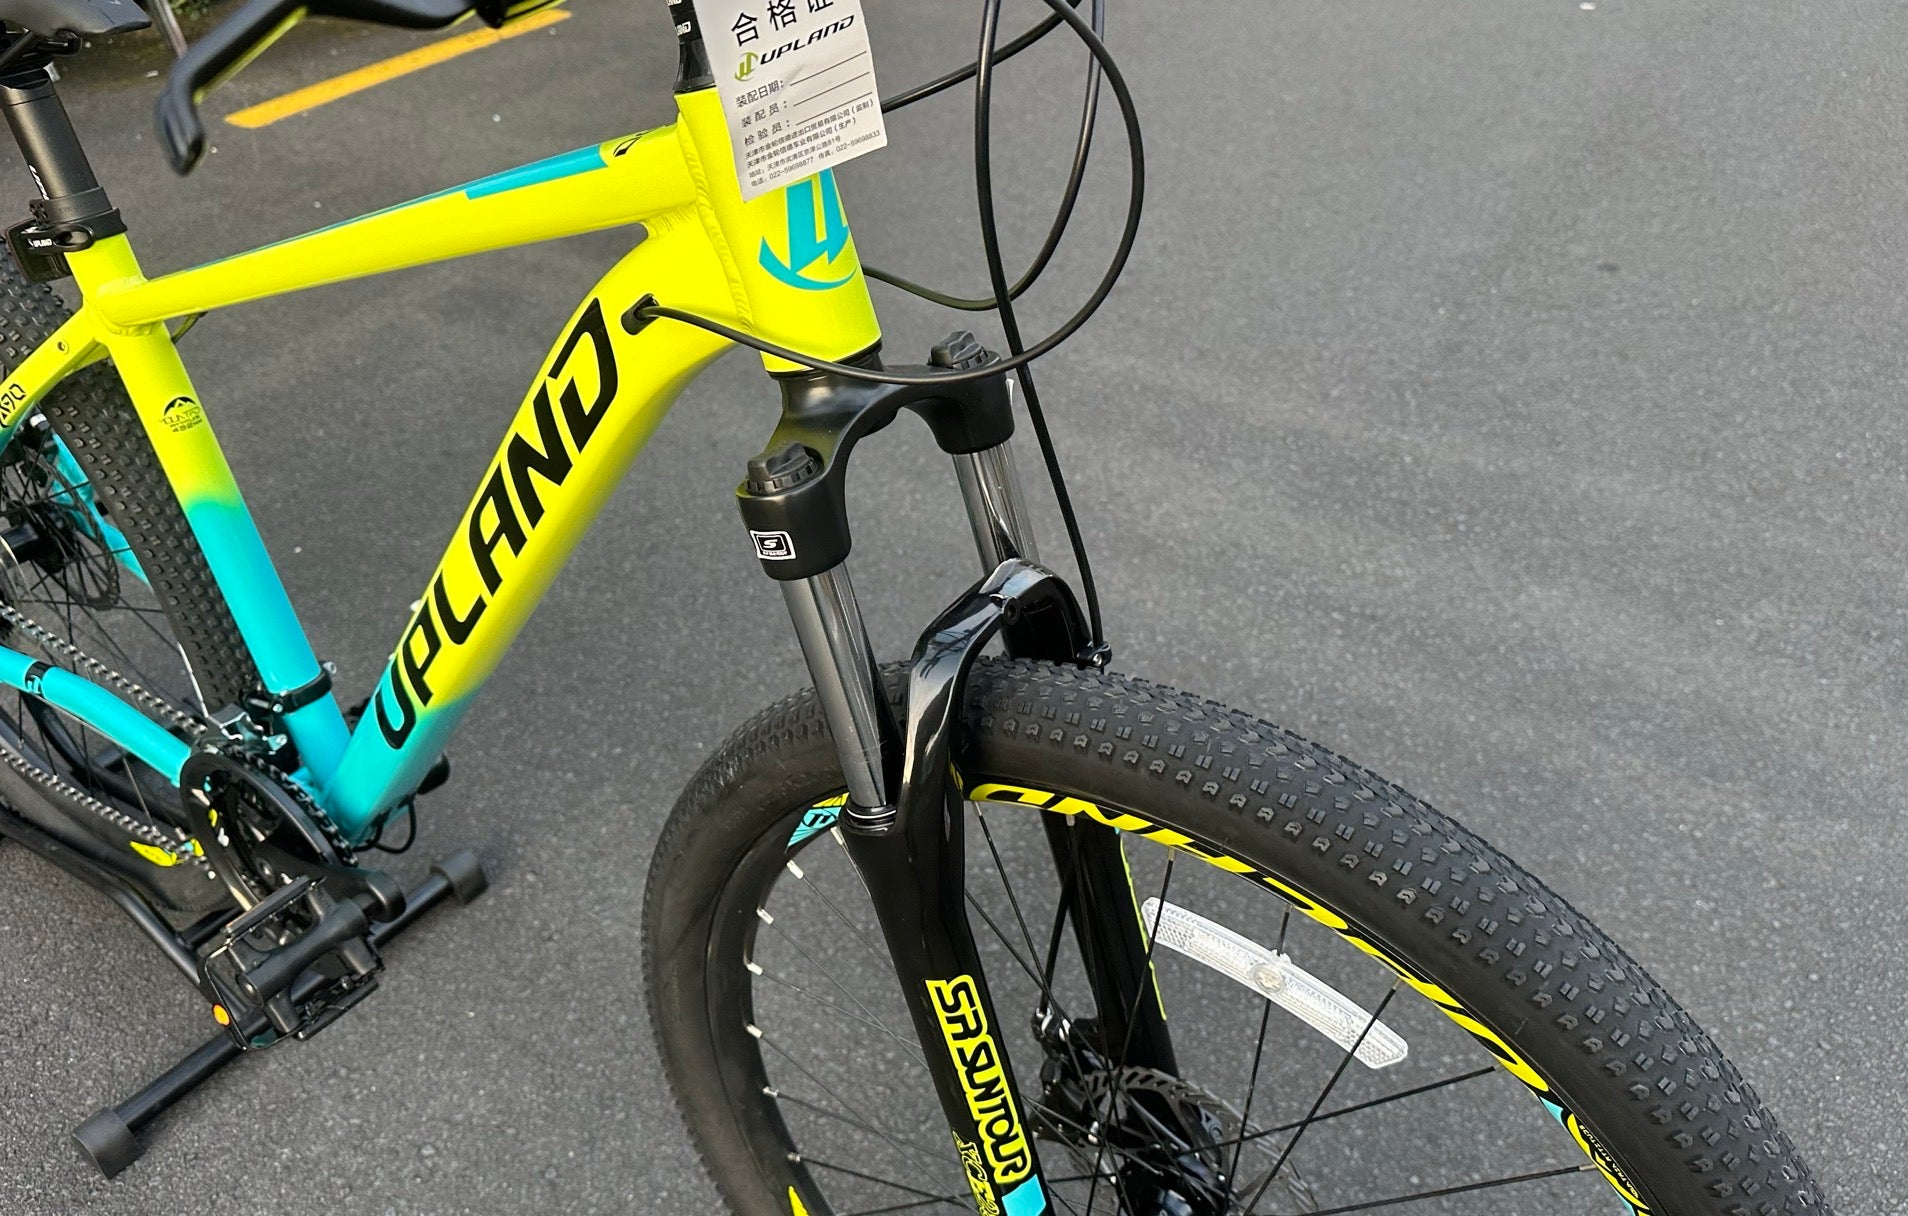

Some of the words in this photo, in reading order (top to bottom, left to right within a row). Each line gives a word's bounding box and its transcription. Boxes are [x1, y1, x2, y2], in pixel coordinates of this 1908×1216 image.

[760, 15, 854, 65] UPLAND
[375, 297, 618, 749] UPLAND
[930, 978, 986, 1041] SR
[954, 1038, 1029, 1180] SUNTOUR
